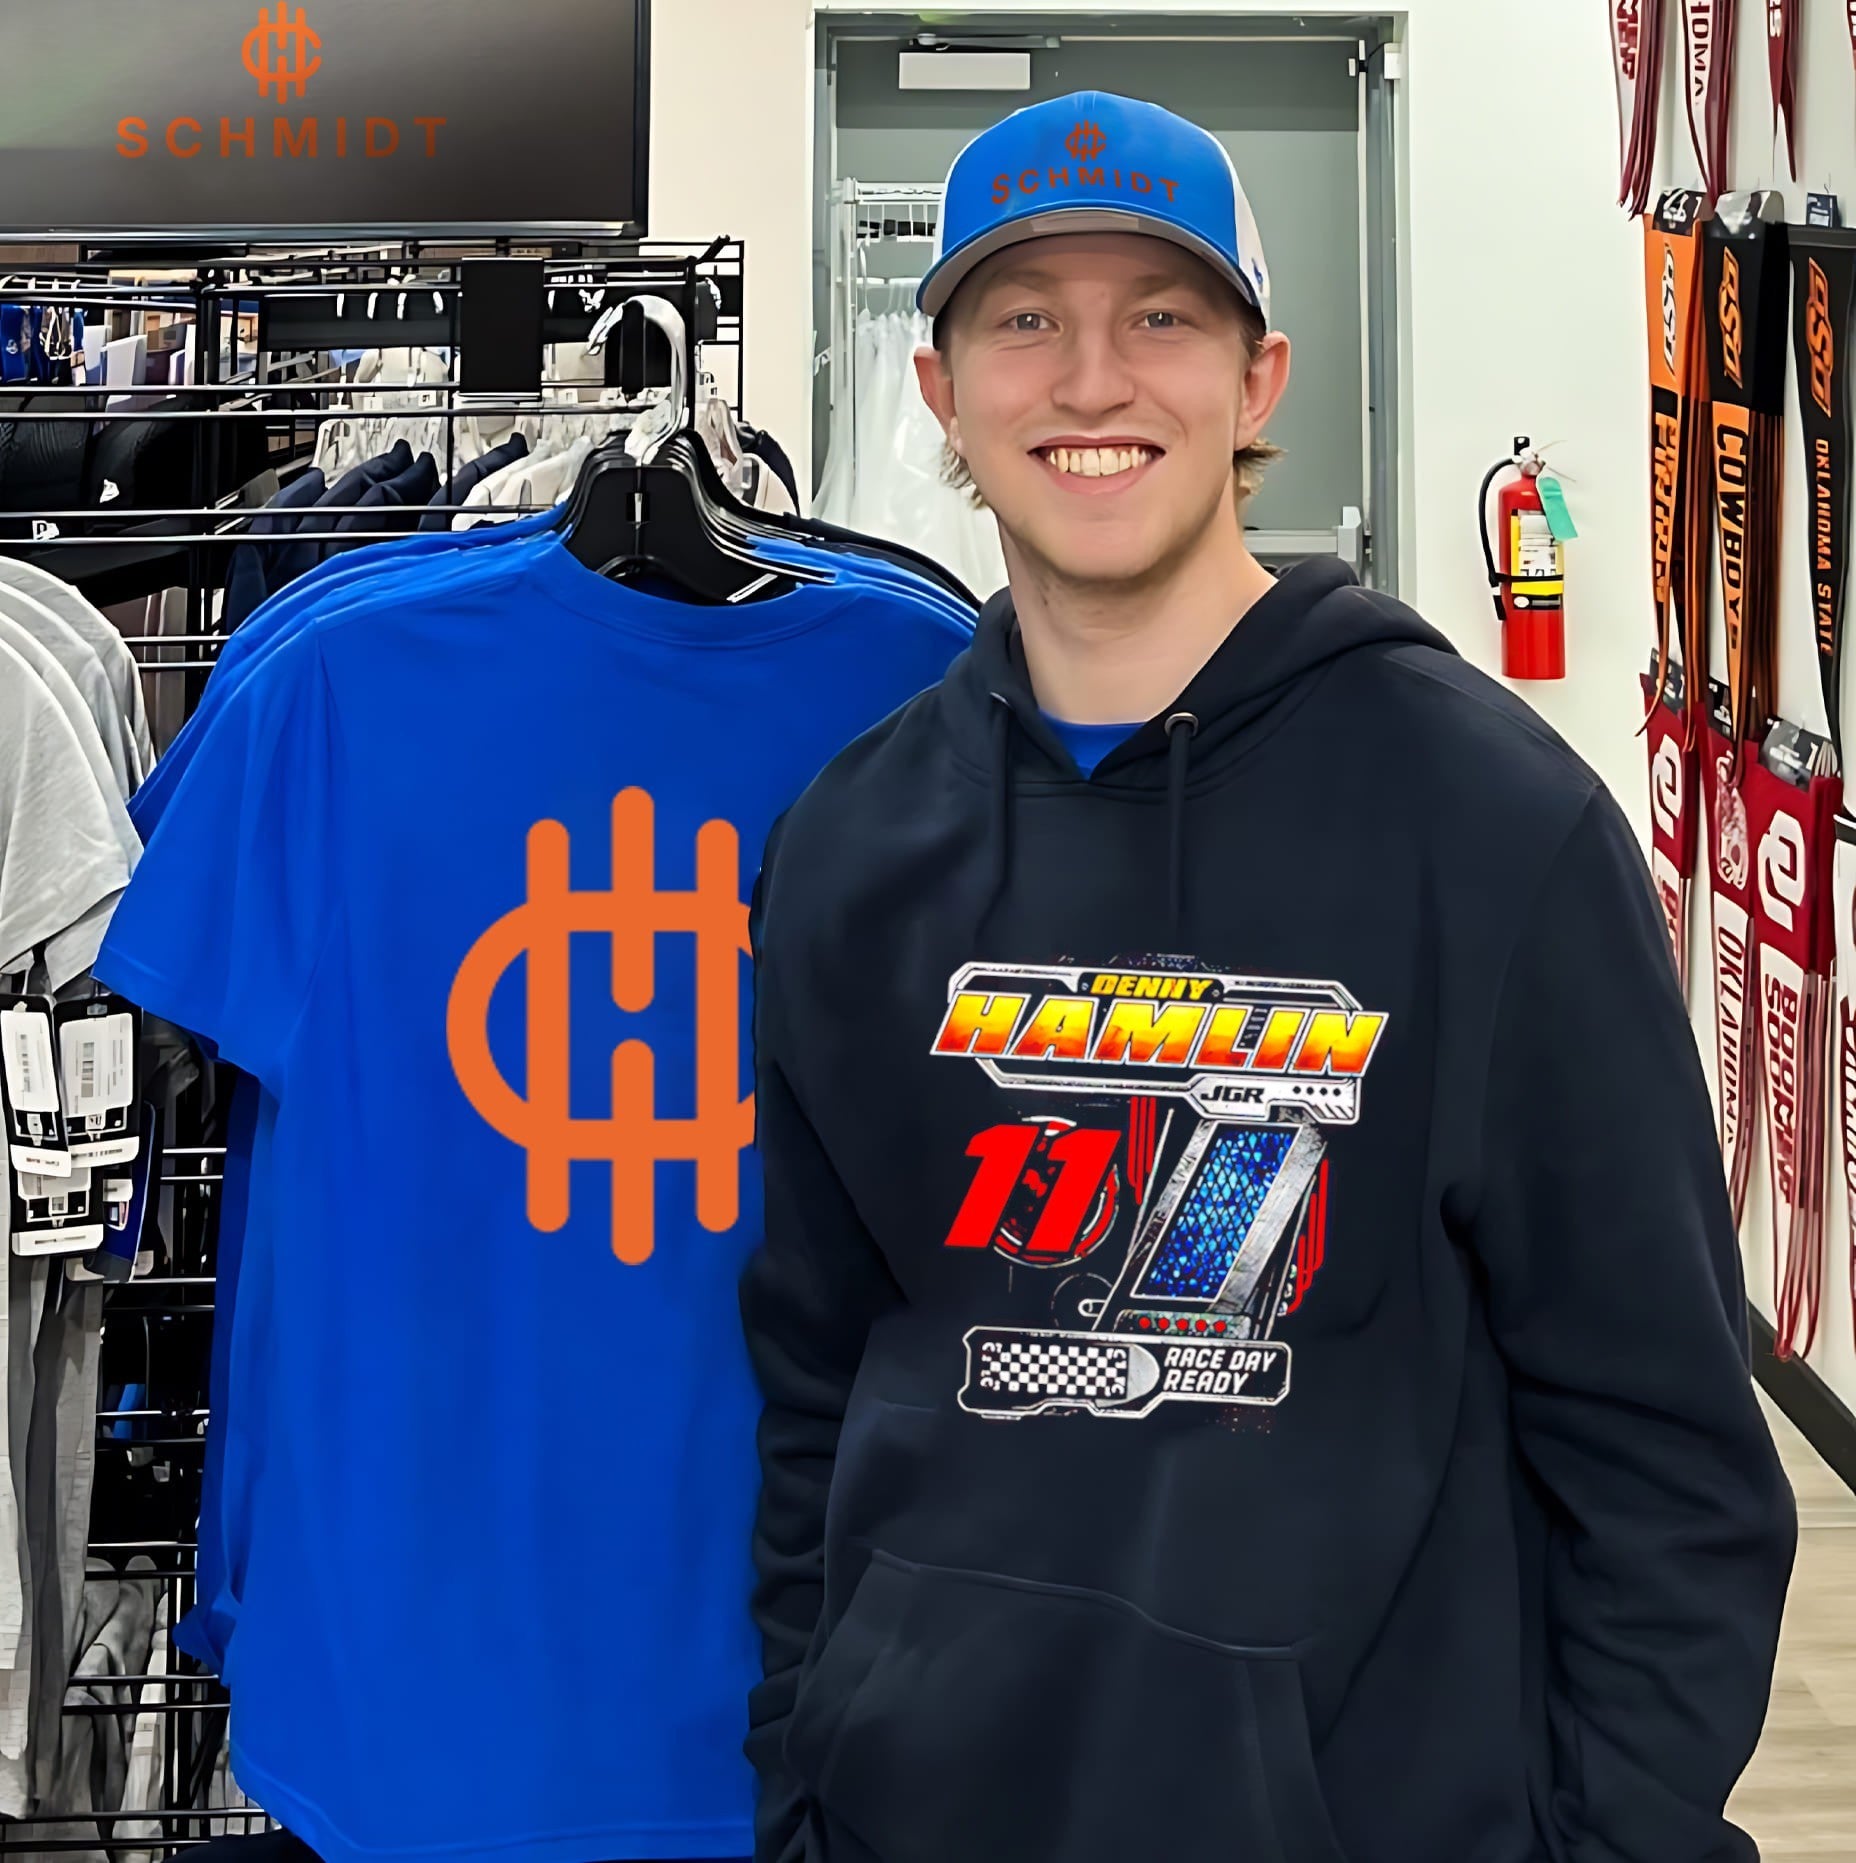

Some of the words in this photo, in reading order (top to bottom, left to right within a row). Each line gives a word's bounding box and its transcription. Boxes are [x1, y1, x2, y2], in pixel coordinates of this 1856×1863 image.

[116, 116, 448, 159] SCHMIDT
[991, 167, 1179, 204] SCHMIDT
[1090, 973, 1213, 1000] DENNY
[930, 990, 1389, 1077] HAMLIN
[1201, 1085, 1265, 1103] JGR
[944, 1124, 1122, 1253] 11
[1163, 1346, 1226, 1369] RACE
[1228, 1349, 1277, 1372] DAY
[1162, 1368, 1250, 1395] READY
